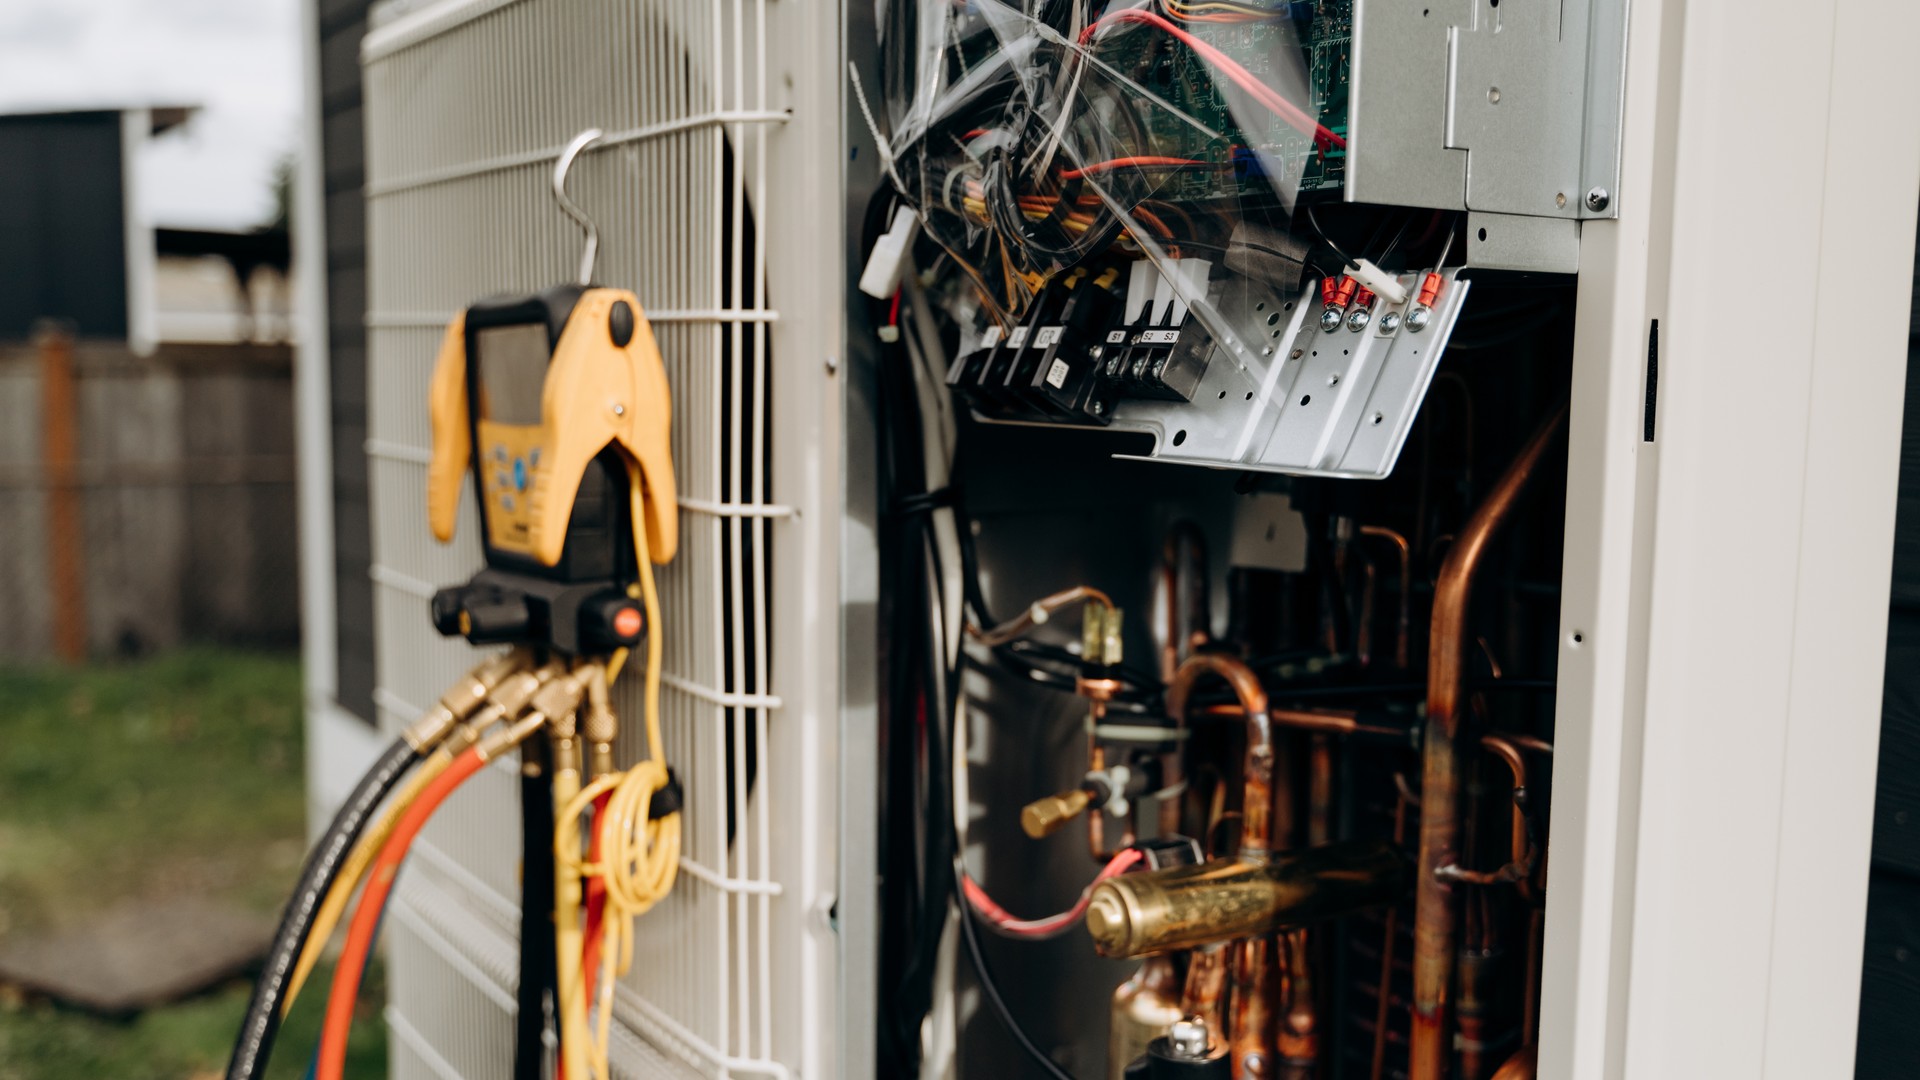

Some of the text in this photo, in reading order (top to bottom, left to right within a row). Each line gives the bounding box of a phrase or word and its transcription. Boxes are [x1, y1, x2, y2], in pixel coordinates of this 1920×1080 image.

[1111, 332, 1122, 341] S1
[1143, 332, 1175, 341] S2 S3
